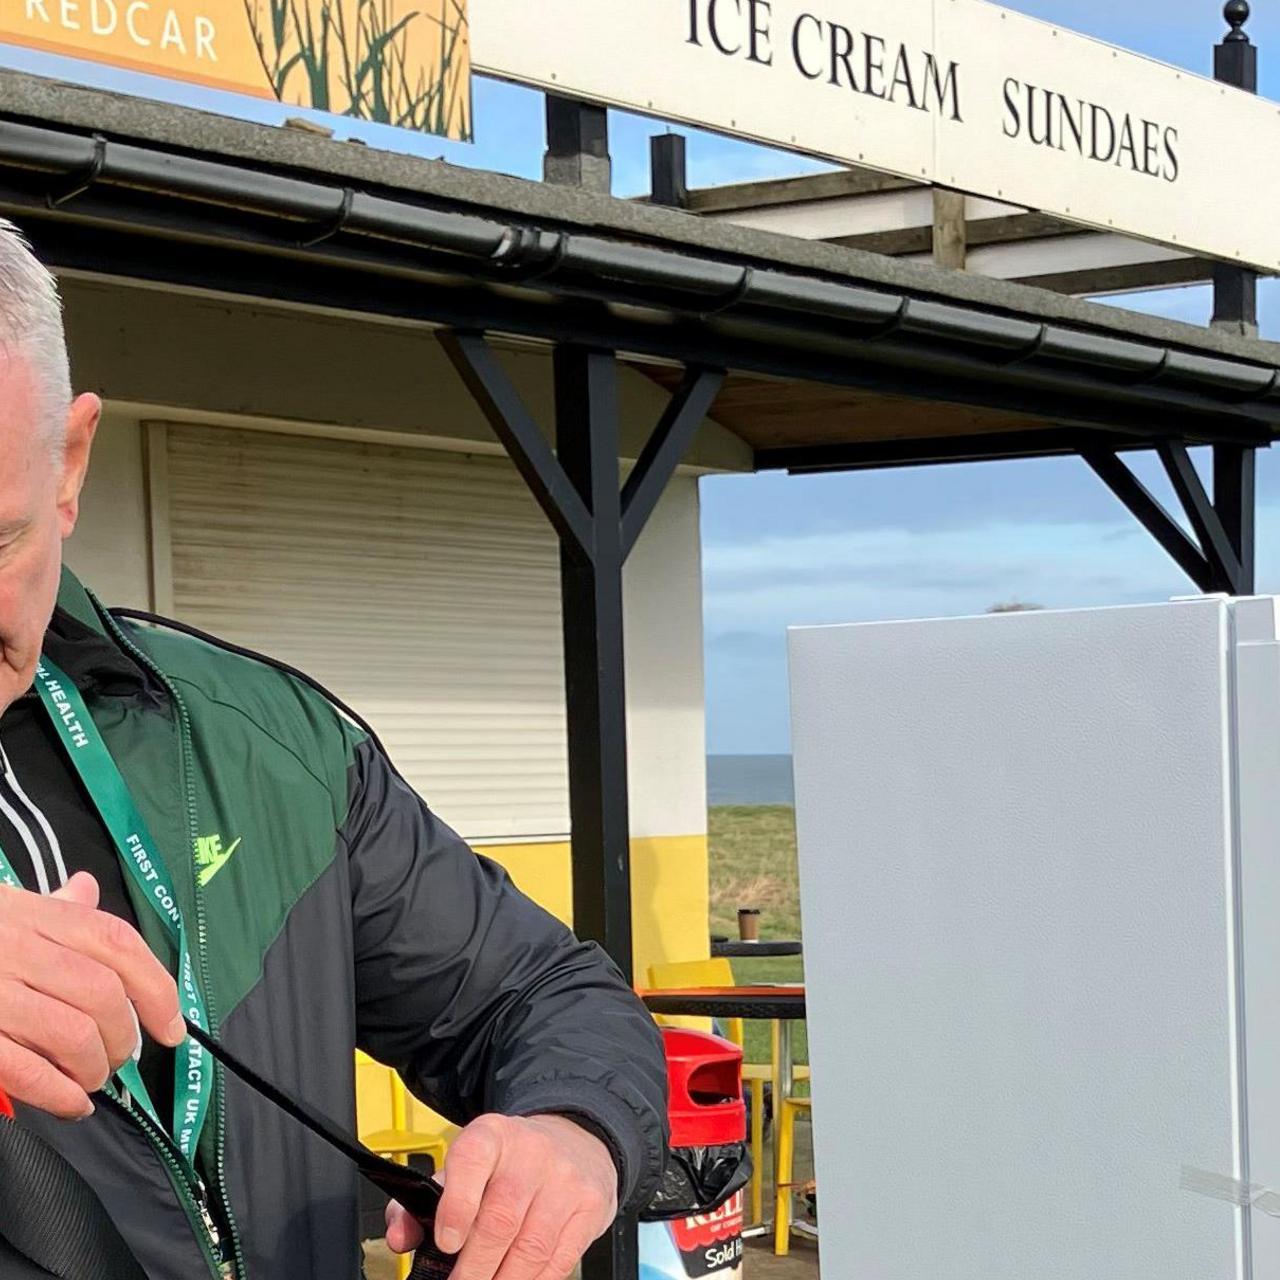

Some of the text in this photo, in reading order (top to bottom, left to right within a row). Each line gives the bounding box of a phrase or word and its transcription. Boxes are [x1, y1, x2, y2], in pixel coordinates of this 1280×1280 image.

[685, 0, 1179, 183] ICE CREAM SUNDAES
[44, 679, 89, 749] HEALTH
[125, 833, 183, 929] FIRST CON
[183, 1099, 200, 1125] UK
[705, 1241, 734, 1268] Sold
